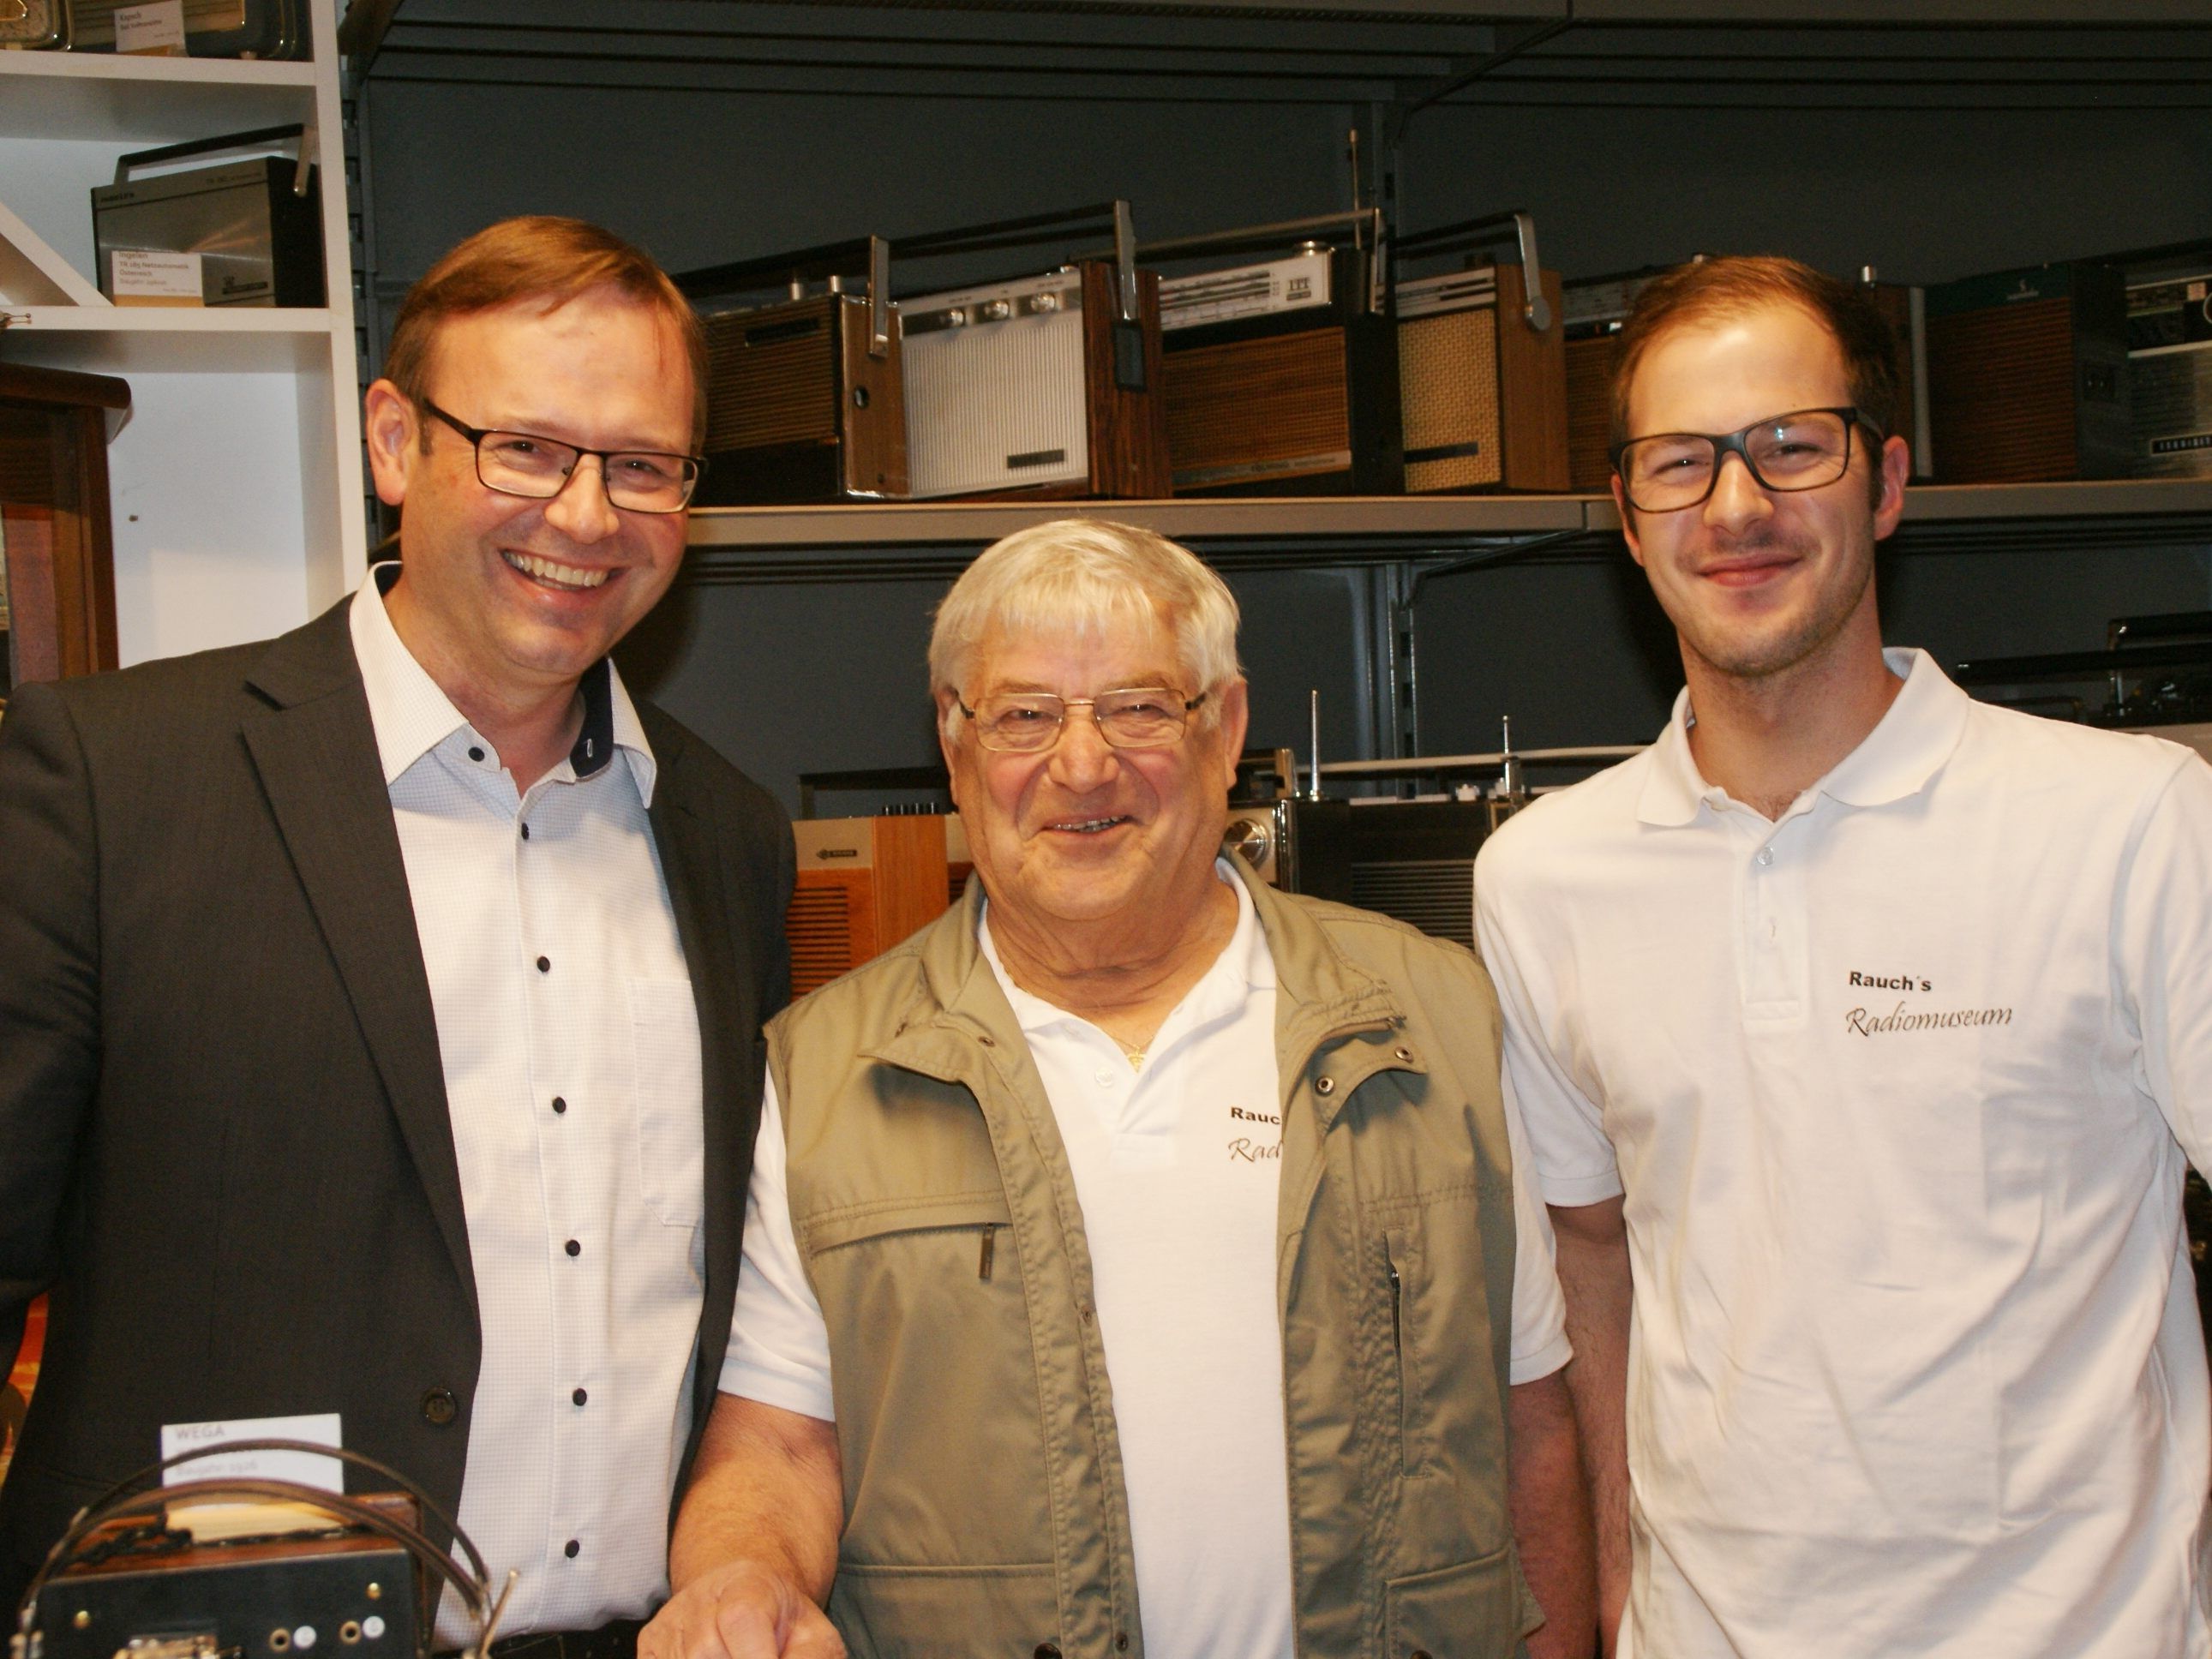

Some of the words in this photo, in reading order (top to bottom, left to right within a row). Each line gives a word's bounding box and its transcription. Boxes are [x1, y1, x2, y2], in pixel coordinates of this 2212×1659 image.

[1289, 277, 1310, 290] ITT
[1845, 1001, 2012, 1037] Radiomuseum
[1231, 1106, 1281, 1125] Rauc
[175, 1425, 225, 1440] WEGA
